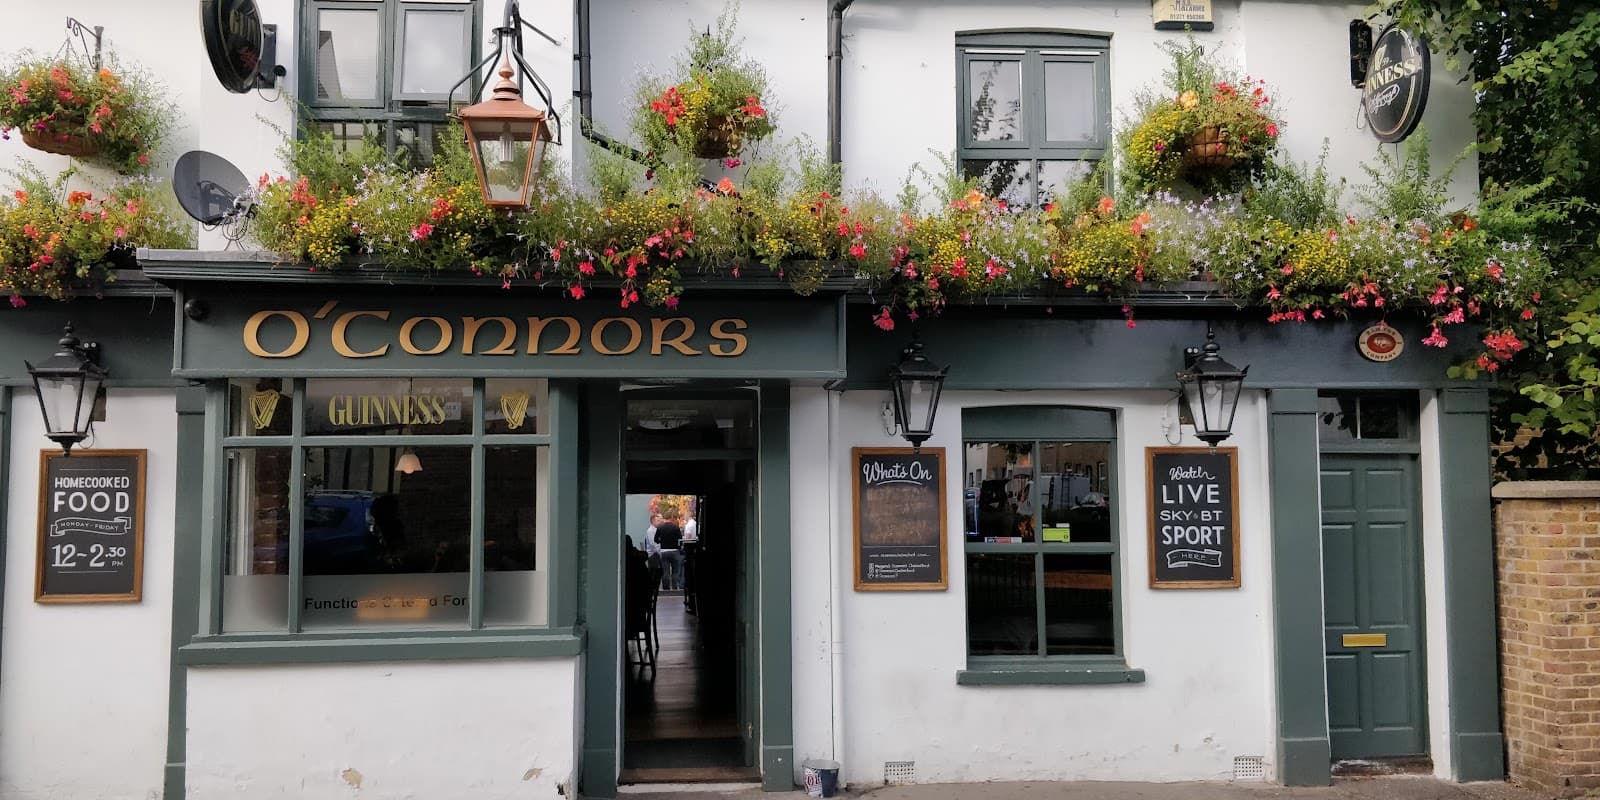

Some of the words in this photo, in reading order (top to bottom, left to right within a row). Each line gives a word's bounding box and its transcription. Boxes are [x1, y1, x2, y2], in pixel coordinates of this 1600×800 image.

[328, 393, 447, 426] GUINNESS
[54, 476, 130, 489] HOMECOOKED
[862, 461, 908, 484] What's
[909, 461, 933, 481] On
[1168, 466, 1216, 481] Watch
[53, 491, 130, 513] FOOD
[1162, 484, 1220, 504] LIVE
[1159, 510, 1193, 521] SKY
[1201, 510, 1223, 521] BT
[1161, 525, 1225, 545] SPORT
[304, 597, 376, 610] Functios
[443, 594, 467, 607] For
